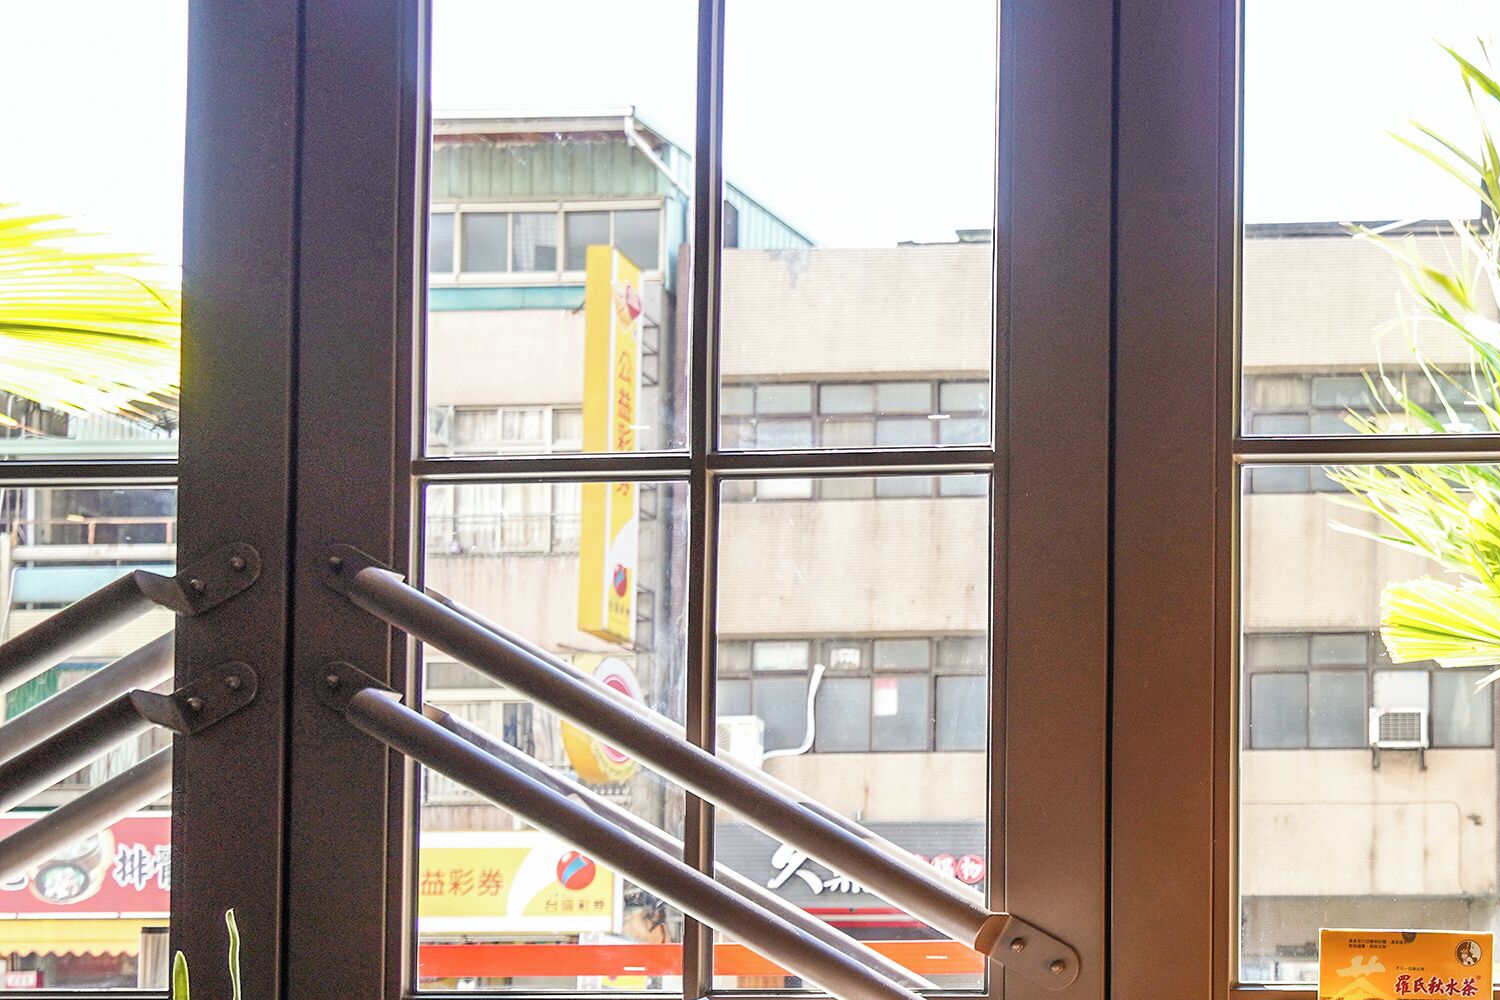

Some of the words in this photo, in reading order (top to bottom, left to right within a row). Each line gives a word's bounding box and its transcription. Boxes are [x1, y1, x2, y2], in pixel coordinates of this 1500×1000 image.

[421, 869, 503, 896] 益彩券
[1394, 974, 1479, 997] 羅氏秋水茶
